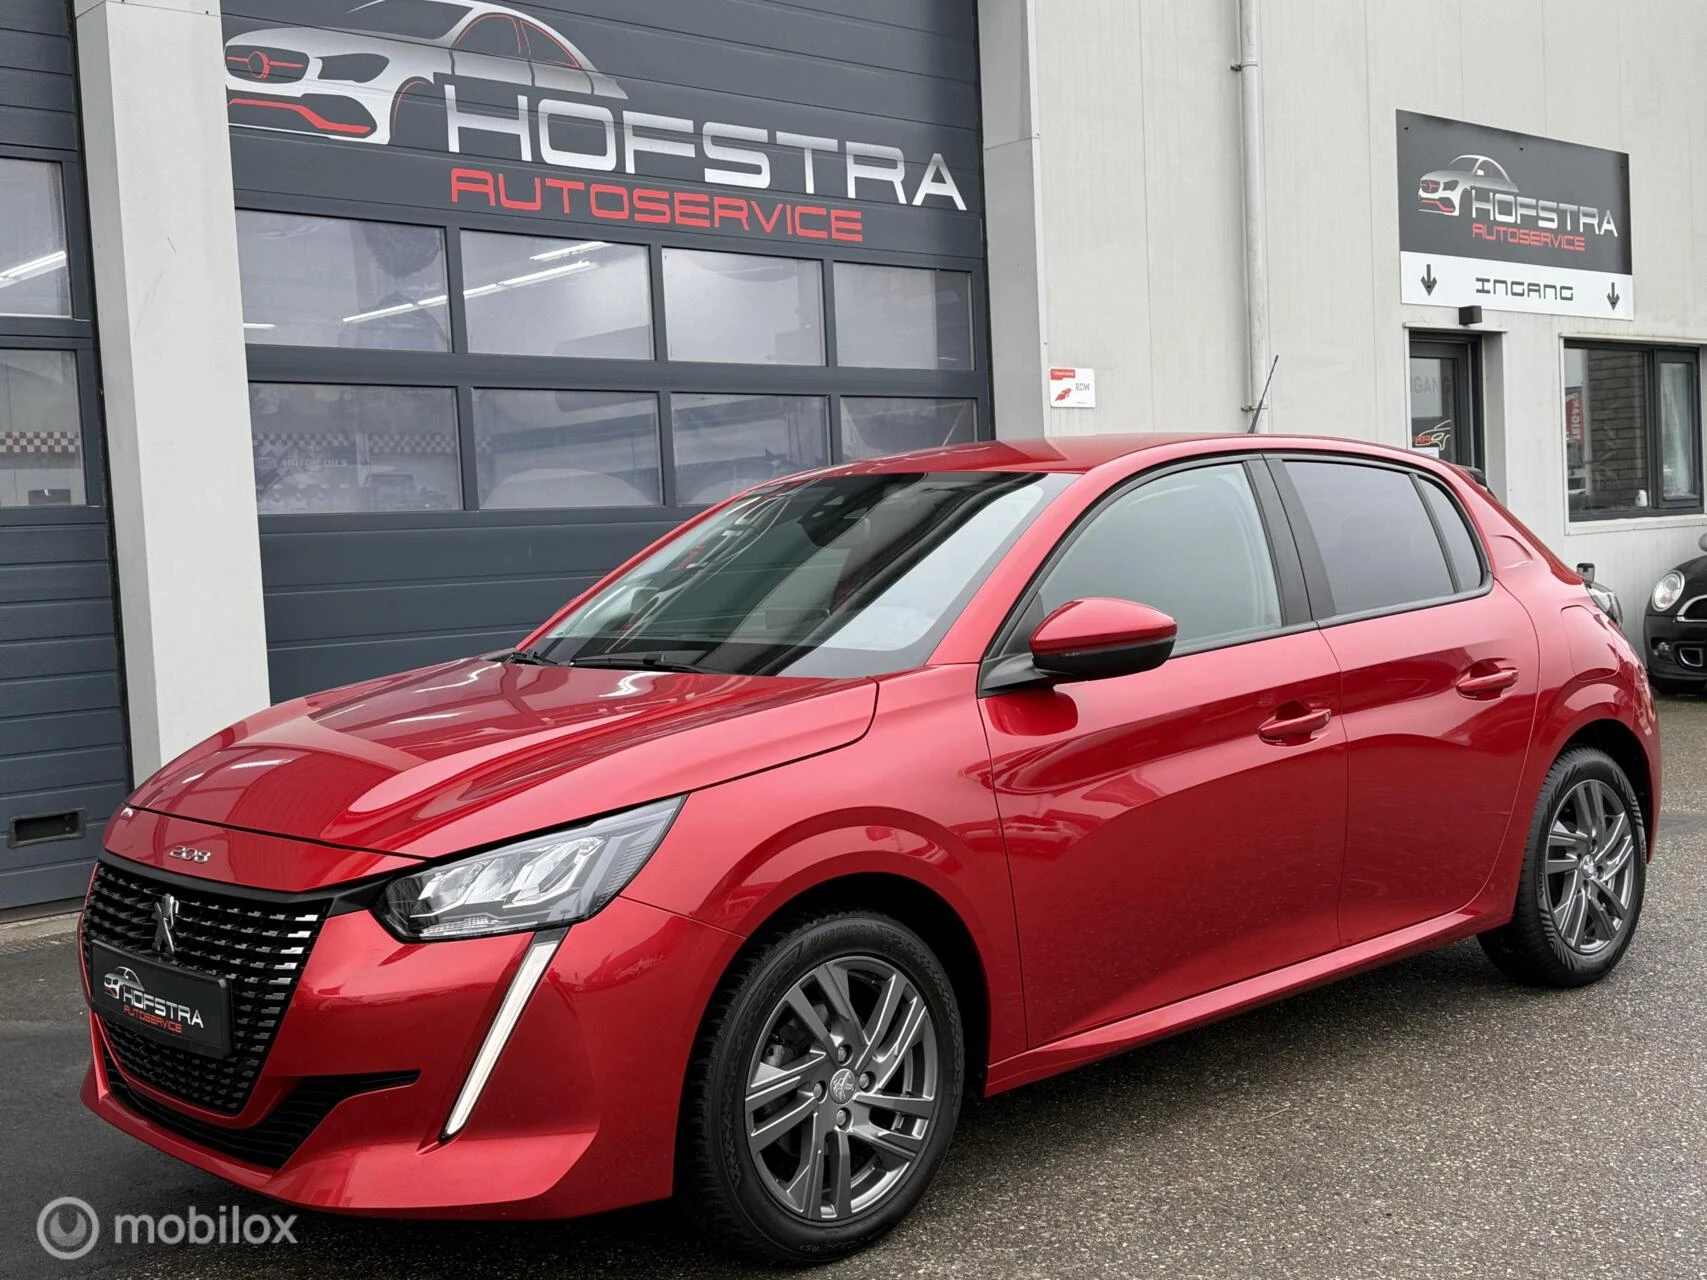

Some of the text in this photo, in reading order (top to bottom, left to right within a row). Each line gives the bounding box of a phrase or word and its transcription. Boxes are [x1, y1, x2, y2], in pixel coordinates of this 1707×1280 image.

[444, 84, 968, 211] HOFSTRA
[450, 168, 863, 242] AUTOSERVICE
[1471, 189, 1619, 238] HOFSTRA
[1472, 223, 1586, 251] AUTOSERVICE
[1475, 277, 1574, 301] INGANG
[170, 846, 211, 863] 208
[123, 985, 204, 1029] HOFSTRA
[123, 1005, 183, 1034] AUTOSERVICE
